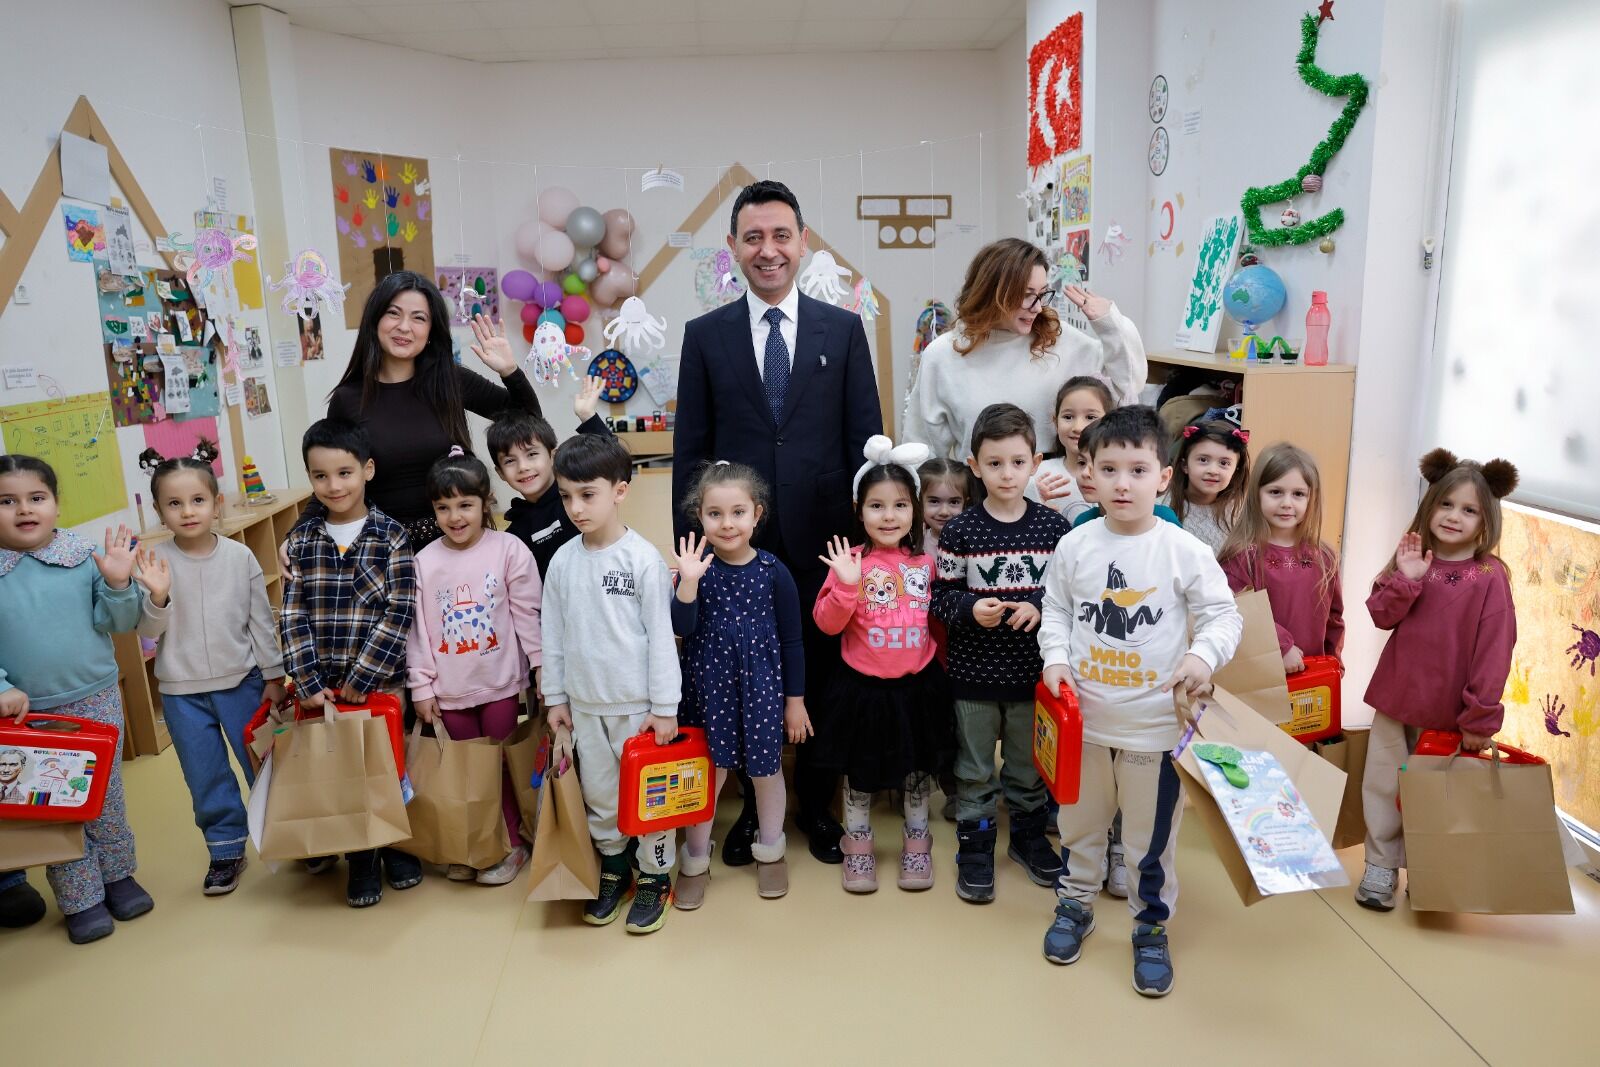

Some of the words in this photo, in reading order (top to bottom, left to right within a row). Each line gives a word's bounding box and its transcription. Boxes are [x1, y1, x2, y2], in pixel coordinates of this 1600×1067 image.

[602, 575, 619, 587] NEW
[1089, 644, 1142, 669] WHO
[1079, 660, 1158, 688] CARES?
[655, 843, 667, 867] RISE
